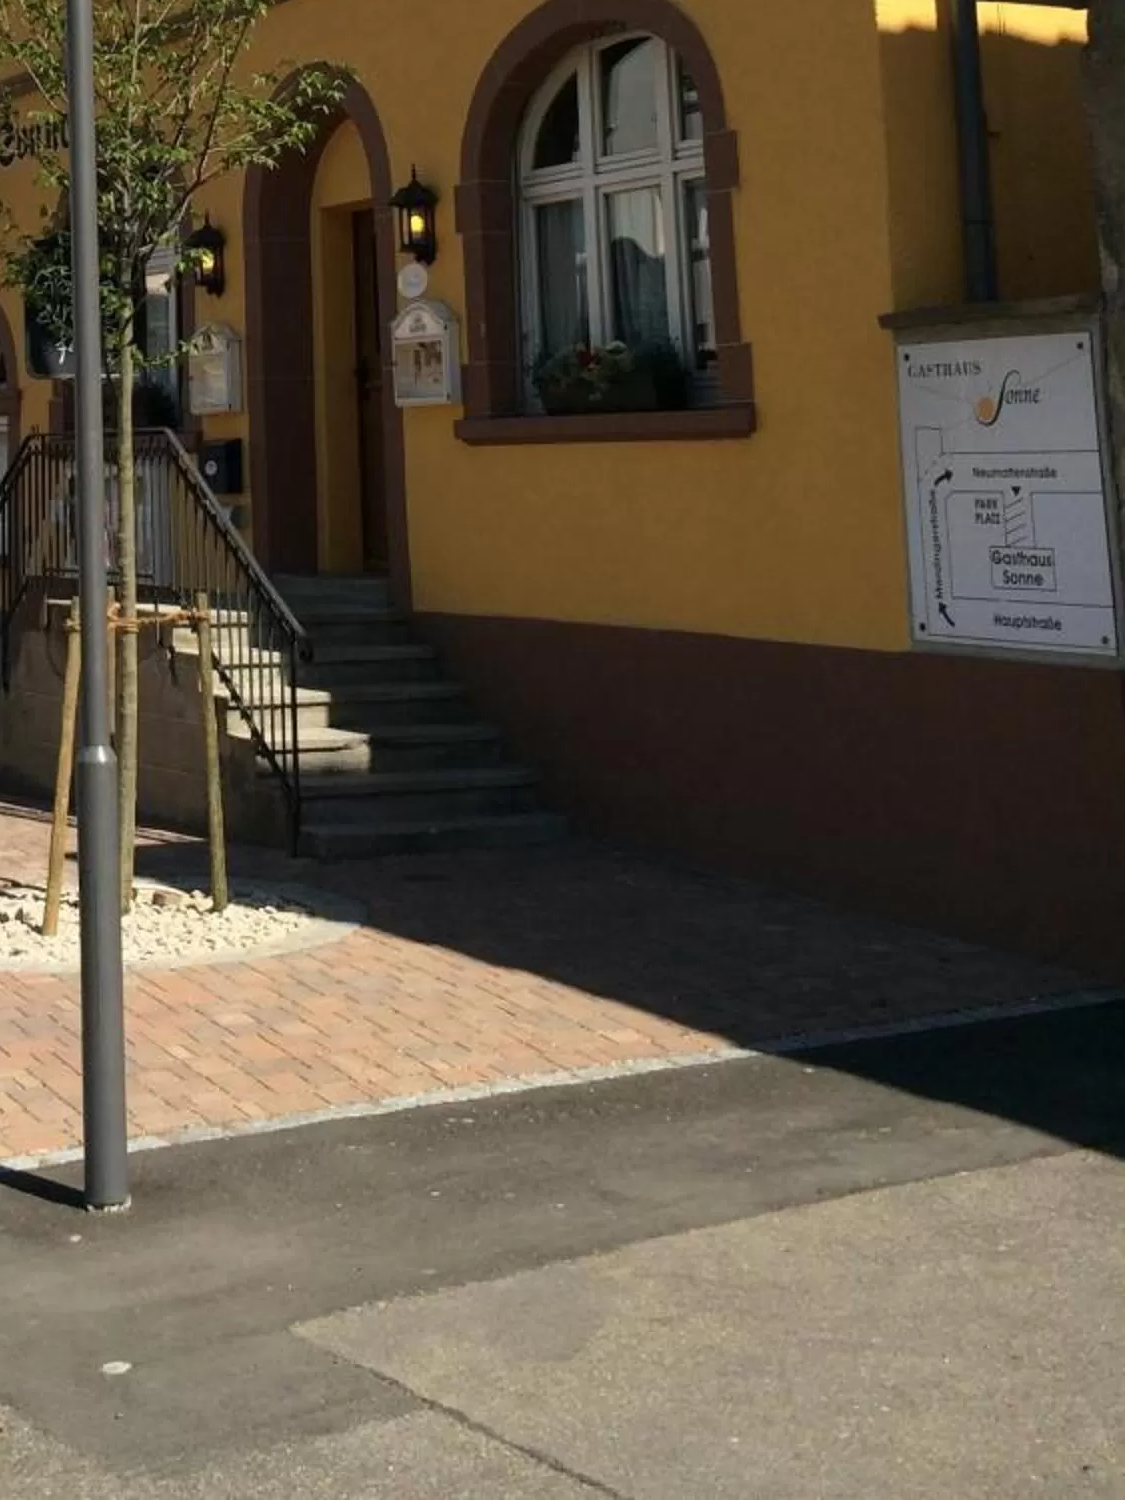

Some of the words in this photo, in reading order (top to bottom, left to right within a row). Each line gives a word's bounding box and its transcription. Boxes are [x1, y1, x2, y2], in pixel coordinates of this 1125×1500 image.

[907, 359, 982, 379] GASTHAUS
[976, 368, 1041, 427] Sonne
[991, 549, 1053, 567] Gasthaus
[1001, 570, 1045, 587] Sonne
[992, 613, 1063, 631] Hauptstraße
